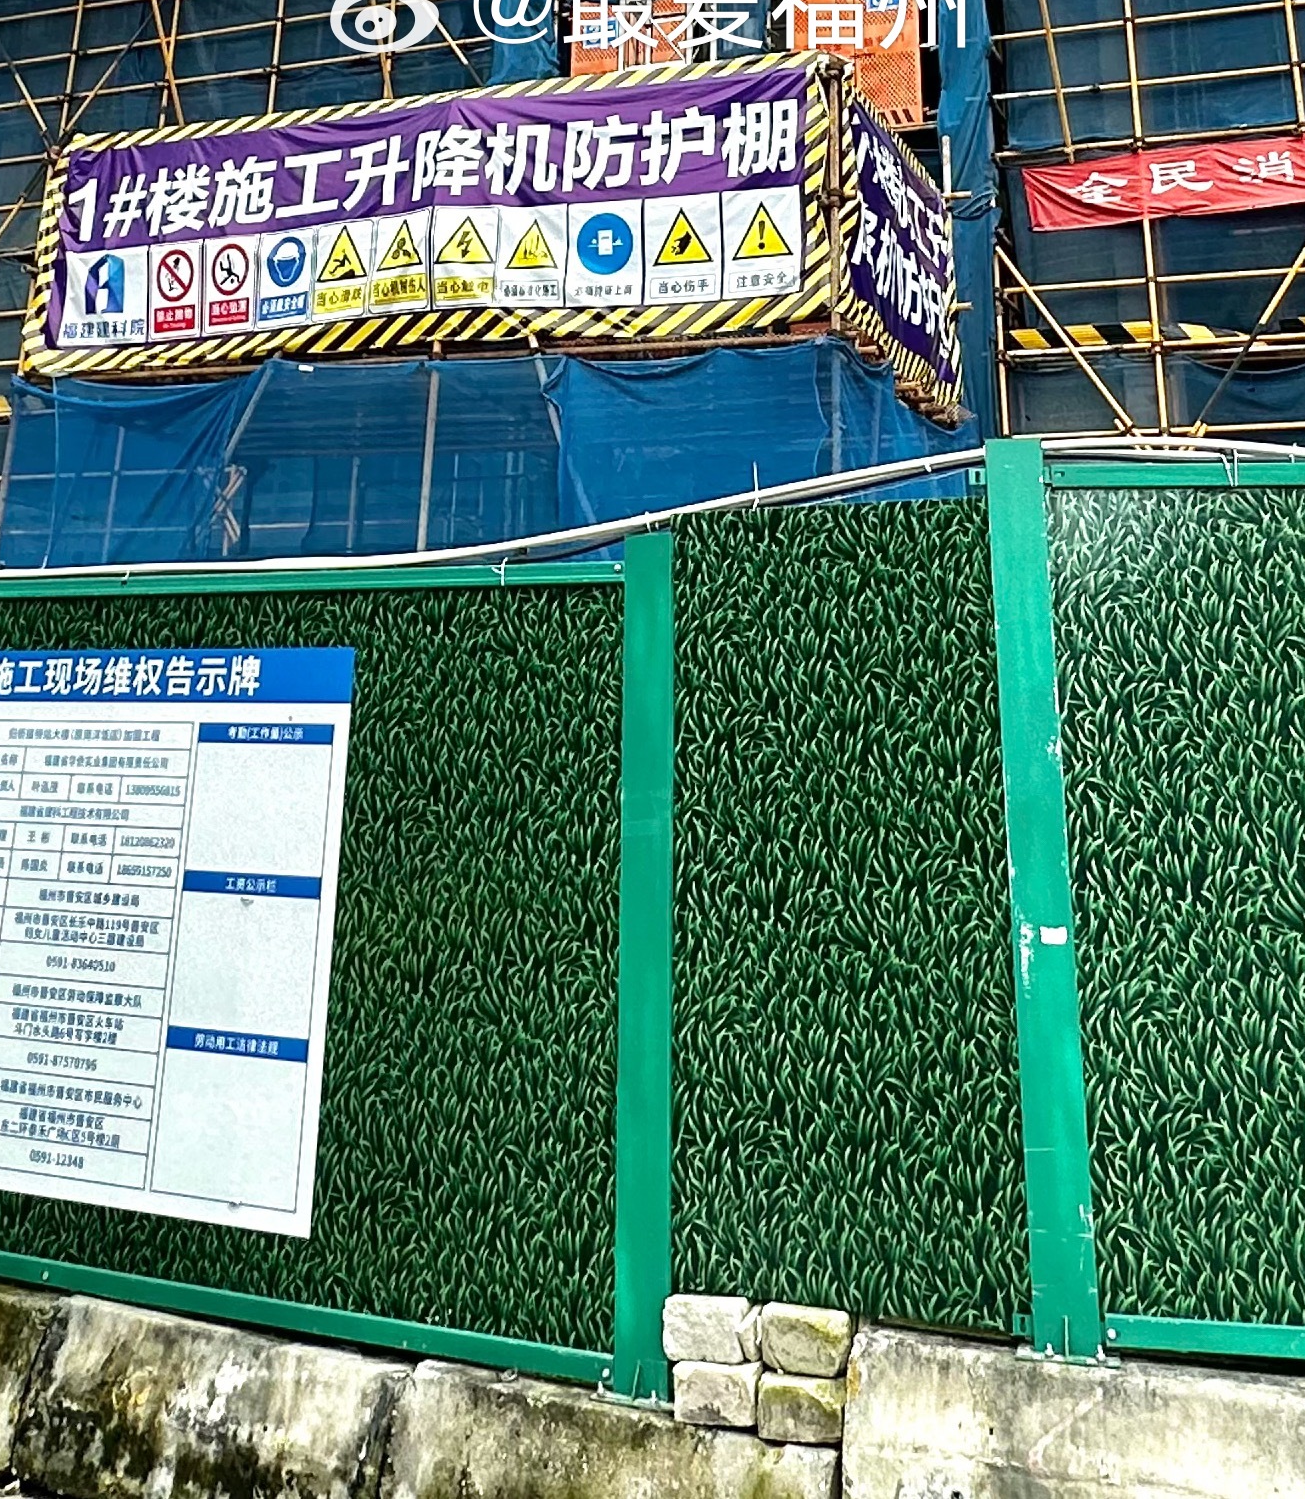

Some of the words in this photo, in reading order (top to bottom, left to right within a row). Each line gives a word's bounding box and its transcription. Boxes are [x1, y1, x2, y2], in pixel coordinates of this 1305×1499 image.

[68, 98, 800, 244] 1#楼施工升降机防护棚
[736, 271, 789, 289] 注意安全
[63, 318, 145, 340] 福建建科院
